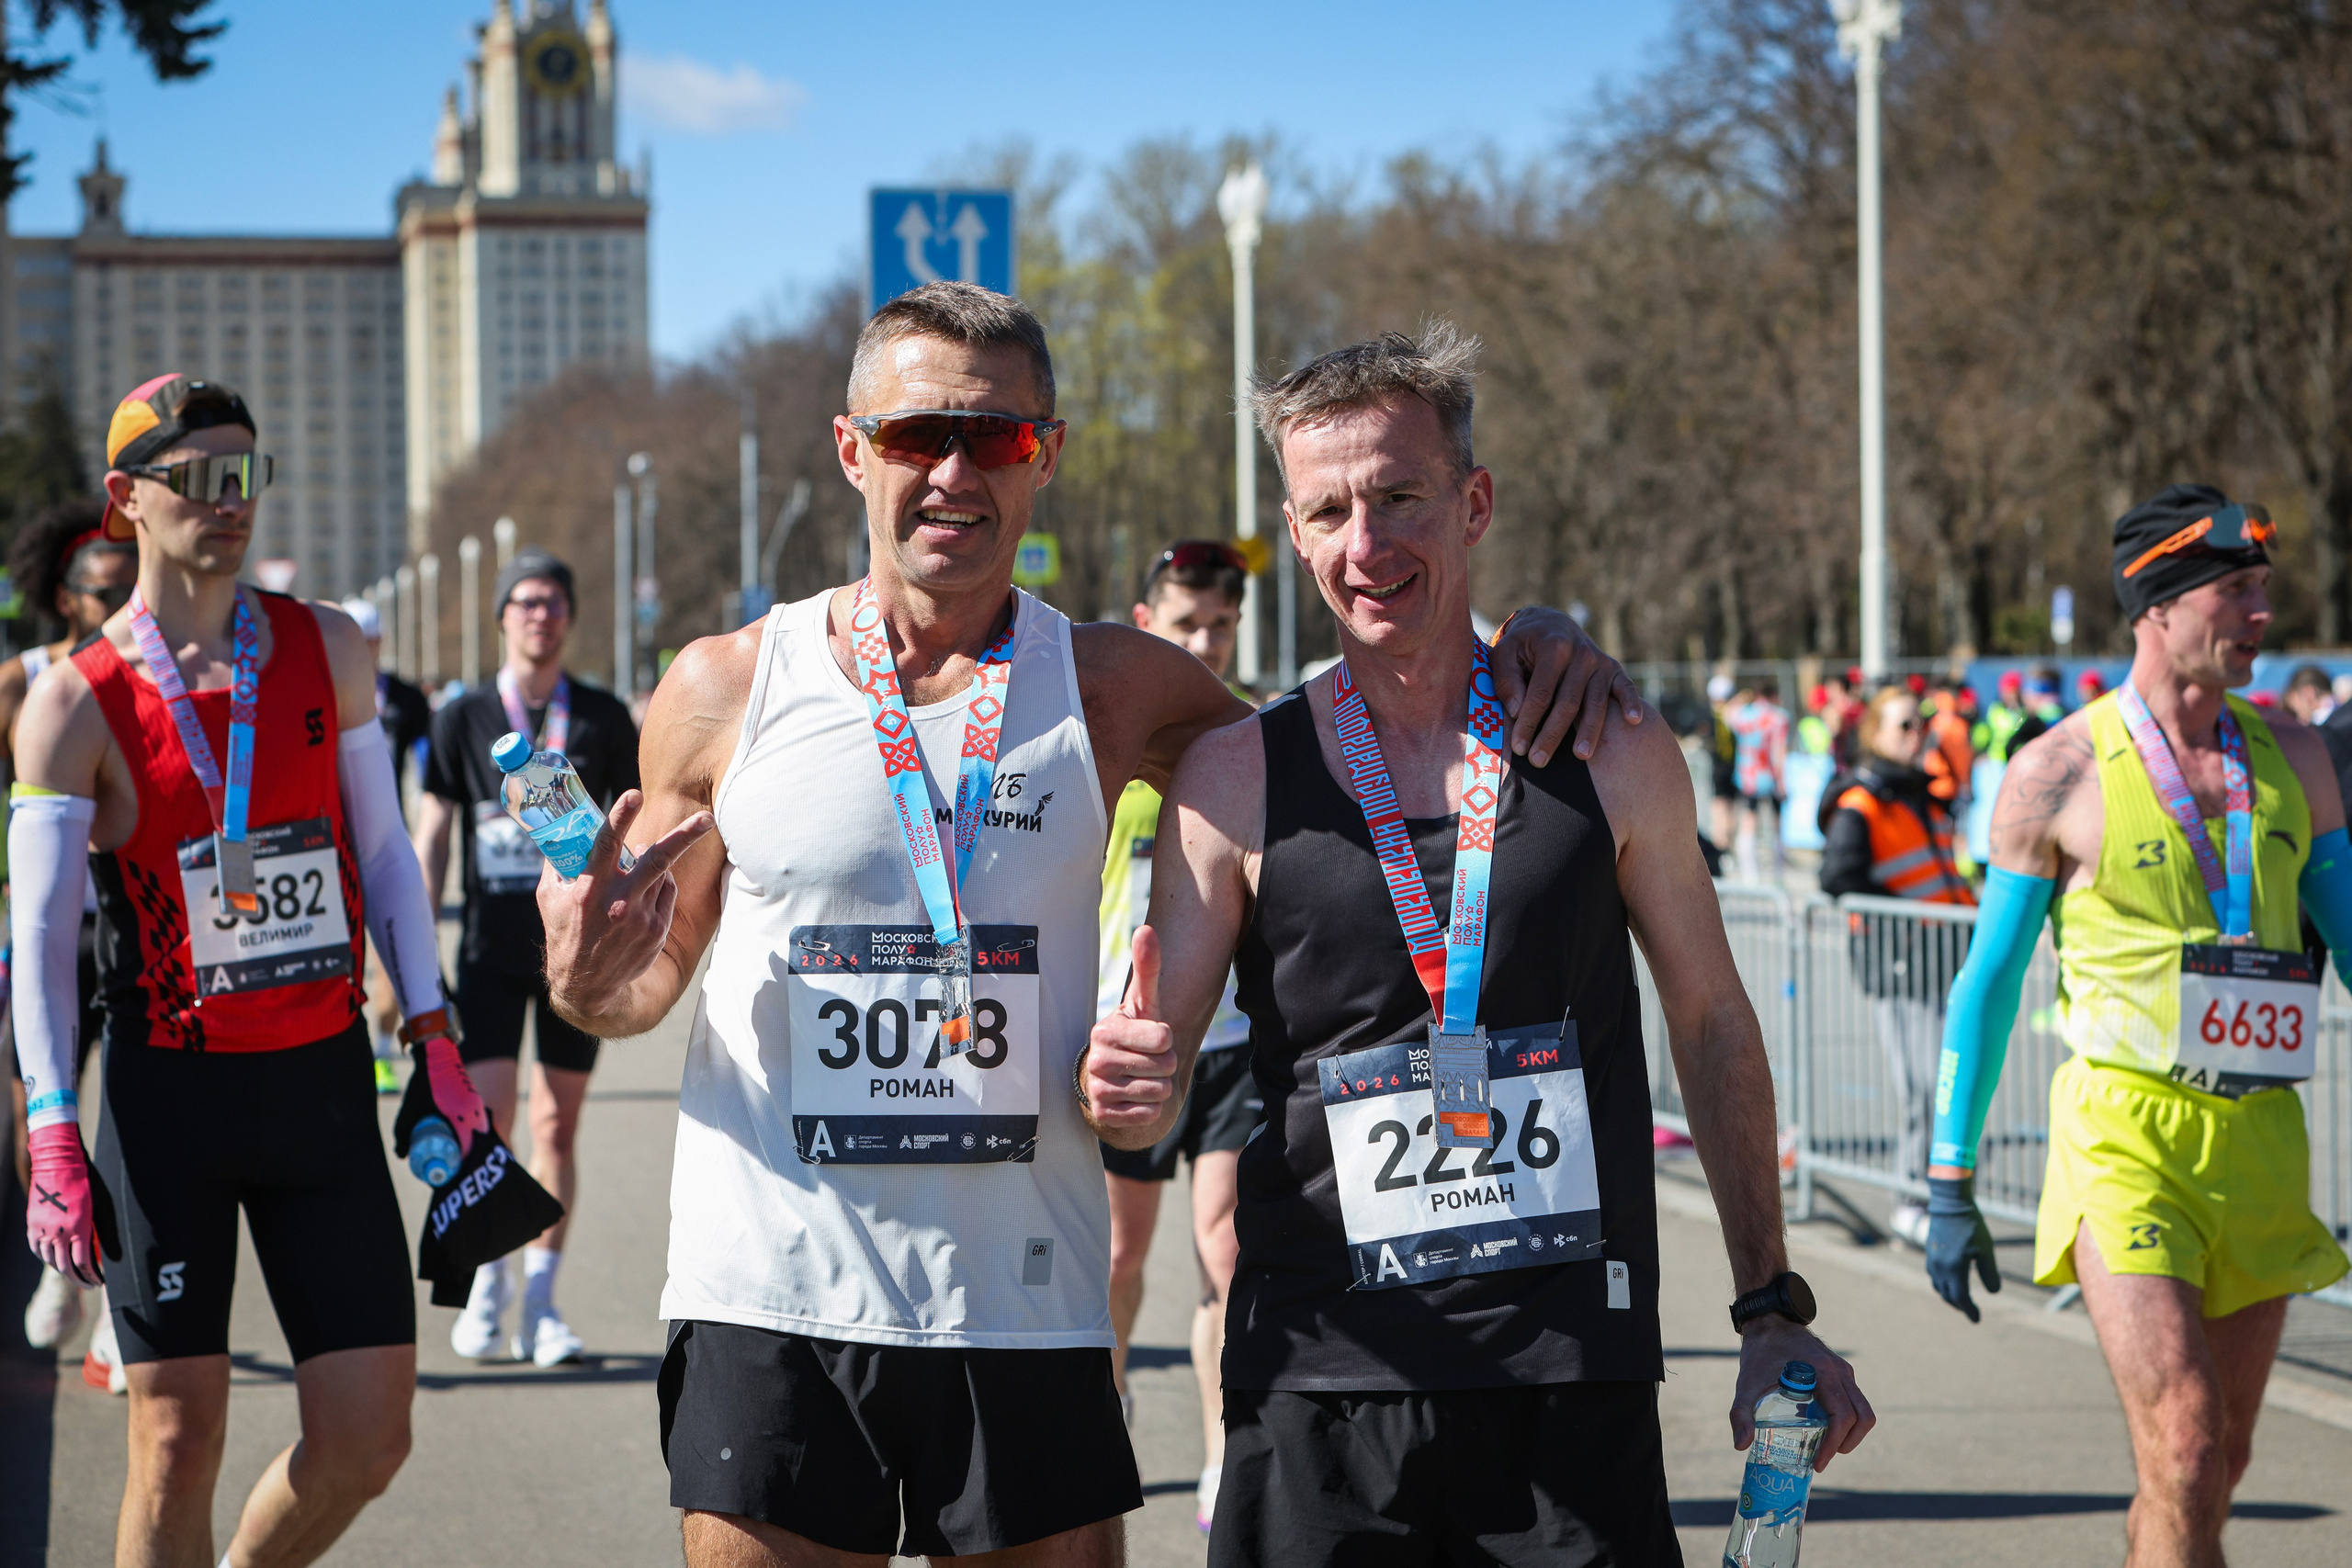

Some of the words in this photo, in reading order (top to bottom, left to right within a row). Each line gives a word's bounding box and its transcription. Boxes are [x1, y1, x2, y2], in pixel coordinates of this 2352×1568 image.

[935, 808, 1042, 833] МКУРИЙ
[955, 773, 969, 848] МОСКОВСКИЙ
[966, 798, 985, 853] МАРАФОН
[893, 793, 923, 868] МОСКОВСКИЙ
[922, 808, 941, 863] МАРАФОН
[960, 818, 970, 851] ПОЛУ
[915, 833, 932, 865] ПОЛУ
[1452, 868, 1468, 945] МОСКОВСКИЙ
[1473, 890, 1487, 947] МАРАФОН
[239, 923, 314, 948] ВЕЛИМИР
[871, 931, 936, 944] МОСКОВСК
[1463, 914, 1474, 946] ПОЛУ
[801, 954, 859, 966] 2026
[871, 944, 906, 955] ПОЛУ
[871, 955, 933, 966] МАРАФОН
[818, 998, 1009, 1070] 3078
[2199, 998, 2303, 1052] 6633
[870, 1078, 955, 1098] РОМАН
[1340, 1074, 1399, 1095] 2026
[913, 1133, 949, 1143] МОСКОВСКИЙ
[1368, 1099, 1561, 1193] 2226
[433, 1145, 516, 1240] UPERS
[1430, 1182, 1516, 1213] РОМАН
[1483, 1237, 1518, 1250] МОСКОВСКИЙ
[1484, 1249, 1501, 1258] СПОРТ
[1749, 1466, 1795, 1495] AQUA
